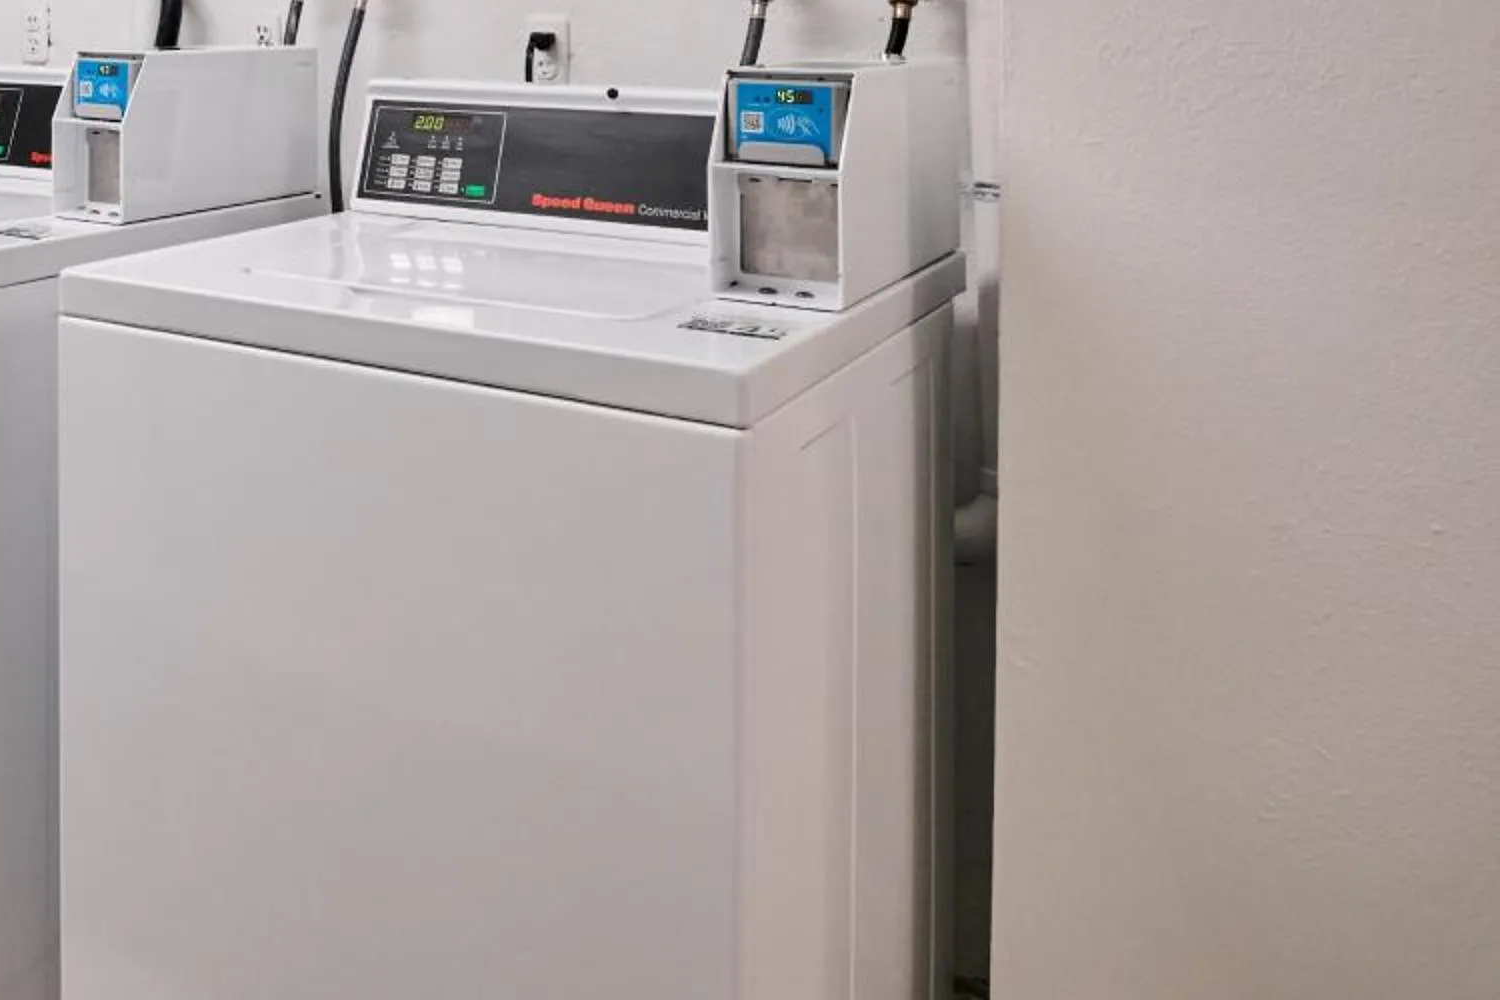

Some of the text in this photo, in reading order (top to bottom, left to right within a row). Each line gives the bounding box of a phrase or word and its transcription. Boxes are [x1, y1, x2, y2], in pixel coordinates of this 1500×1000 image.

[777, 89, 795, 103] 45
[531, 193, 581, 210] Speed
[583, 197, 636, 215] Queen
[638, 203, 700, 221] Commercial
